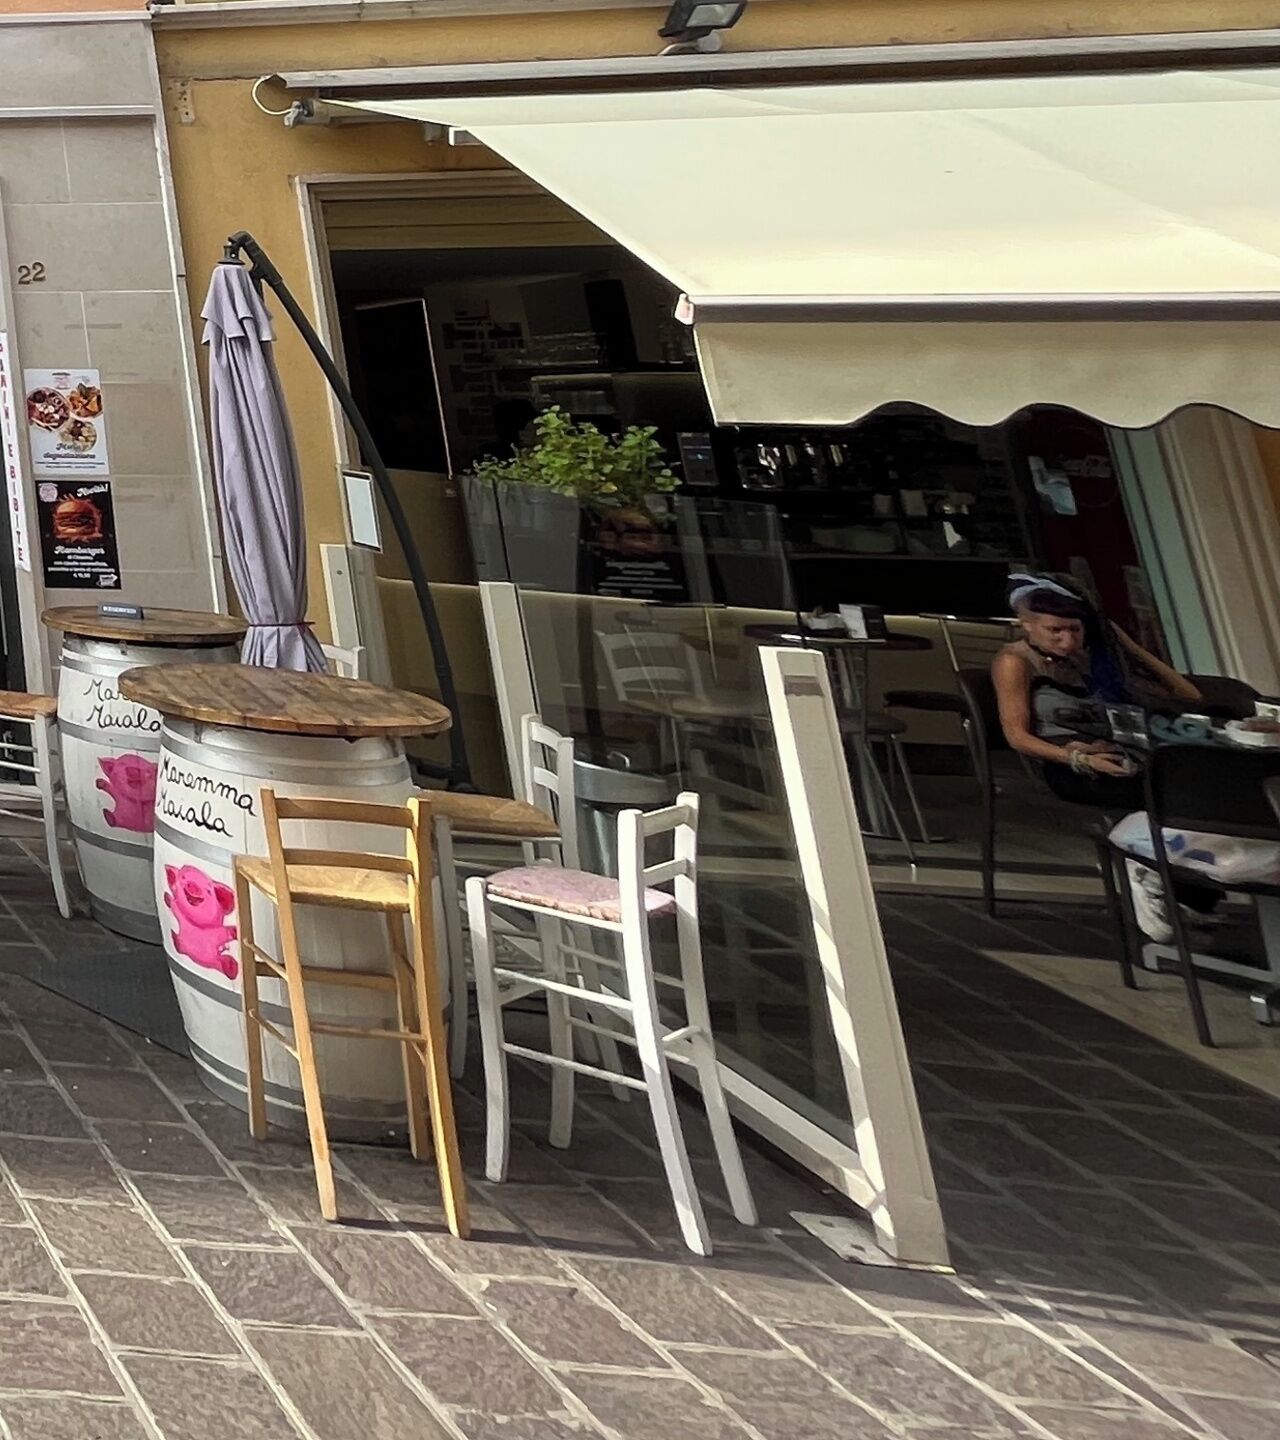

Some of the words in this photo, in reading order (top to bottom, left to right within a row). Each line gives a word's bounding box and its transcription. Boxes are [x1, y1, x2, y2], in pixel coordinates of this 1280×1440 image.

[17, 261, 46, 285] 22
[86, 705, 161, 732] Maiala
[159, 755, 258, 818] Maremma
[157, 788, 234, 838] Maiala
